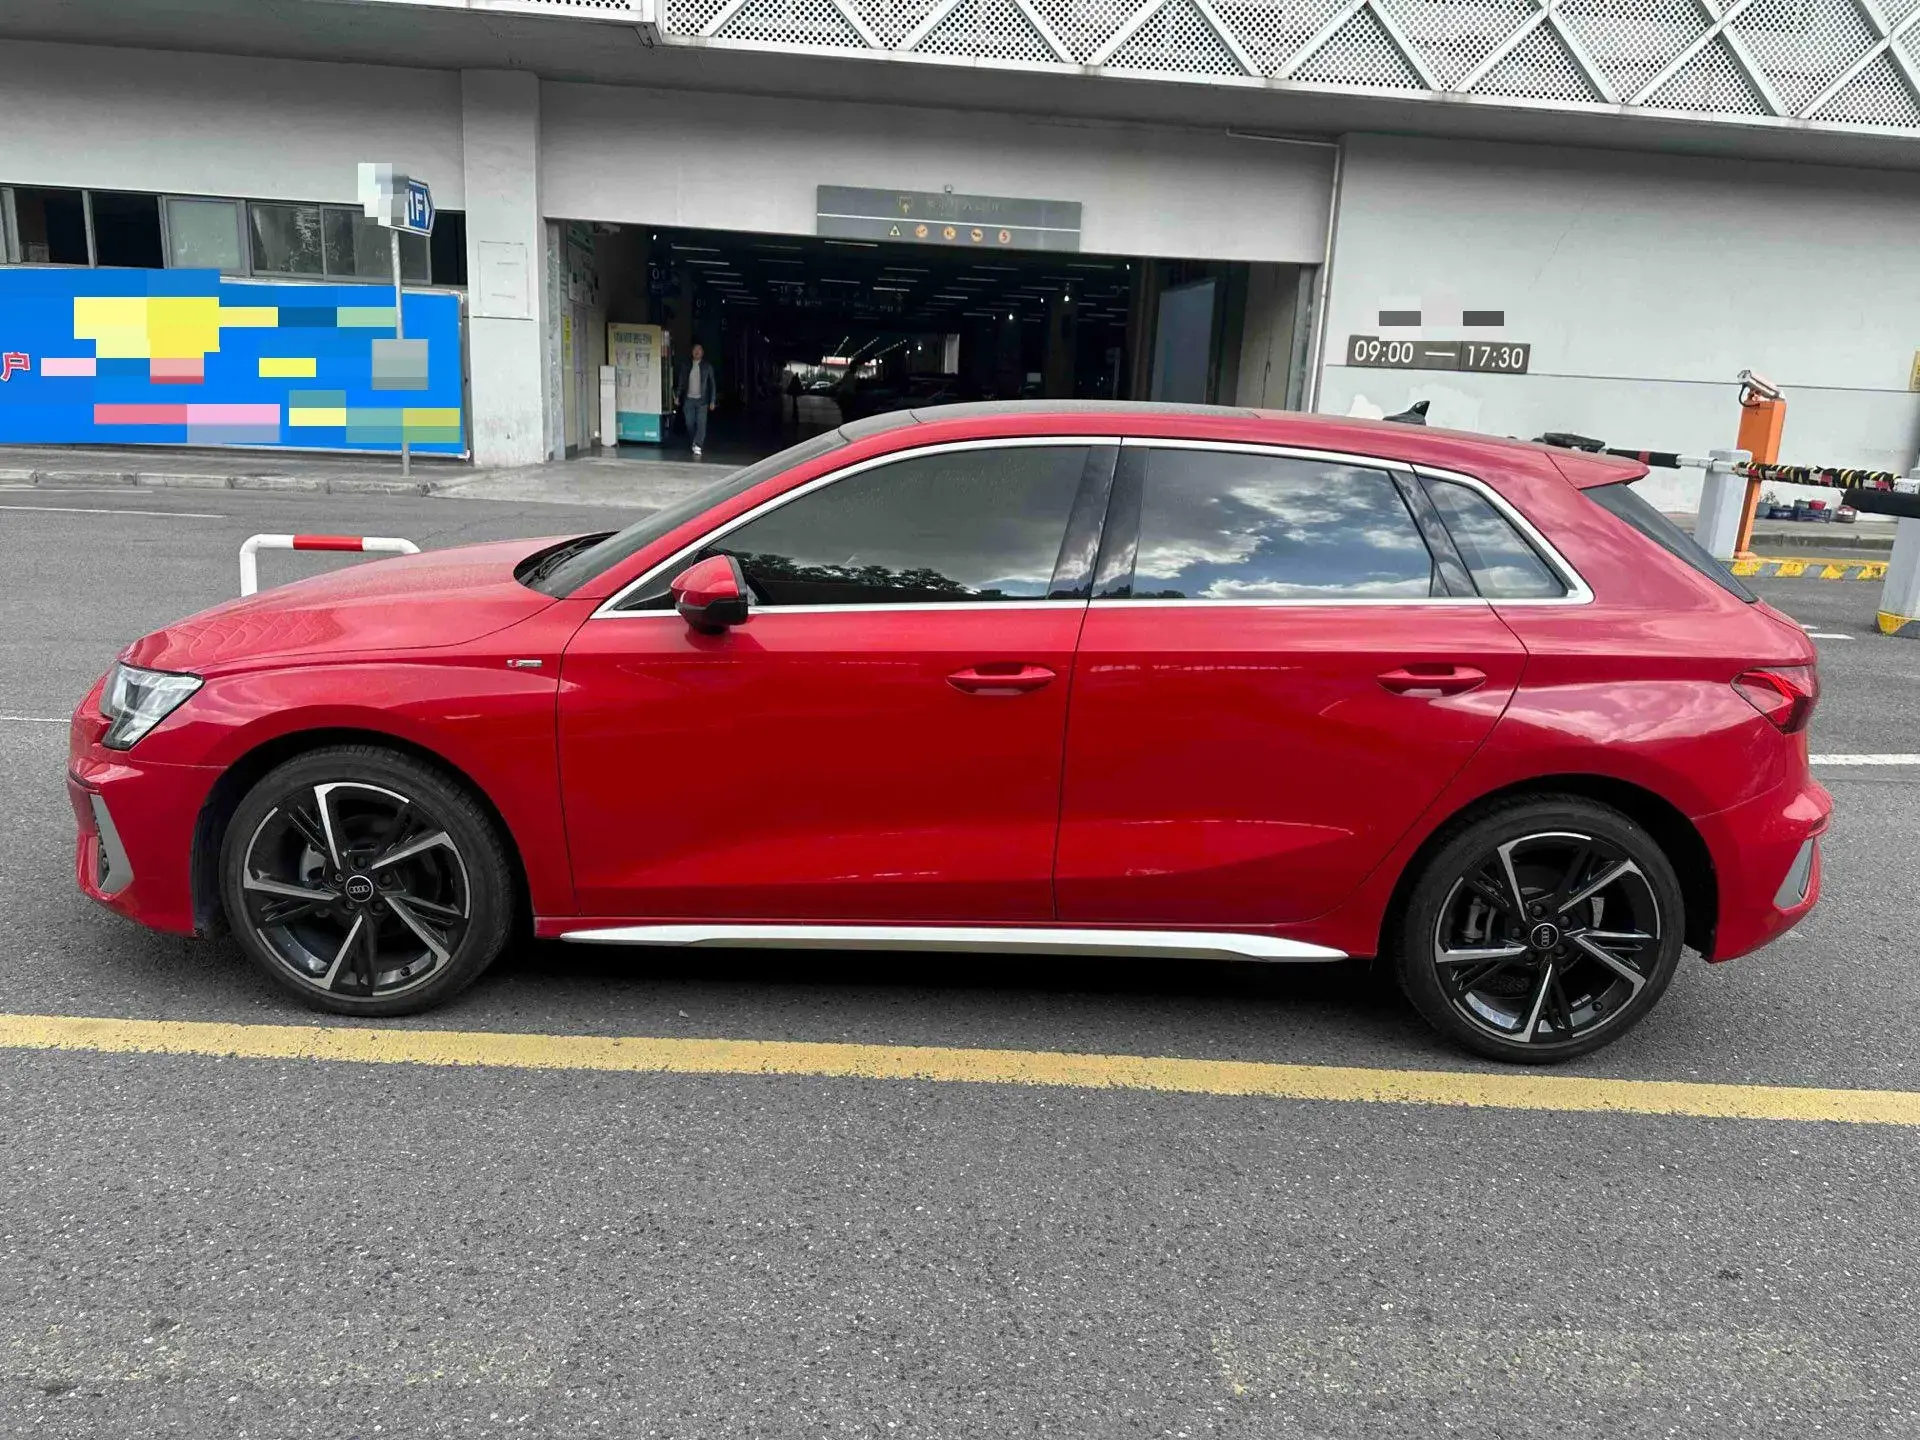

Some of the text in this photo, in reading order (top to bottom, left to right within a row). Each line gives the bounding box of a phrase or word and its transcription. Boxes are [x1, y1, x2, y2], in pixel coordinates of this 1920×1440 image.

[410, 190, 423, 221] 1F
[0, 351, 31, 382] 户
[1354, 340, 1414, 364] 09:00
[1468, 345, 1524, 369] 17:30
